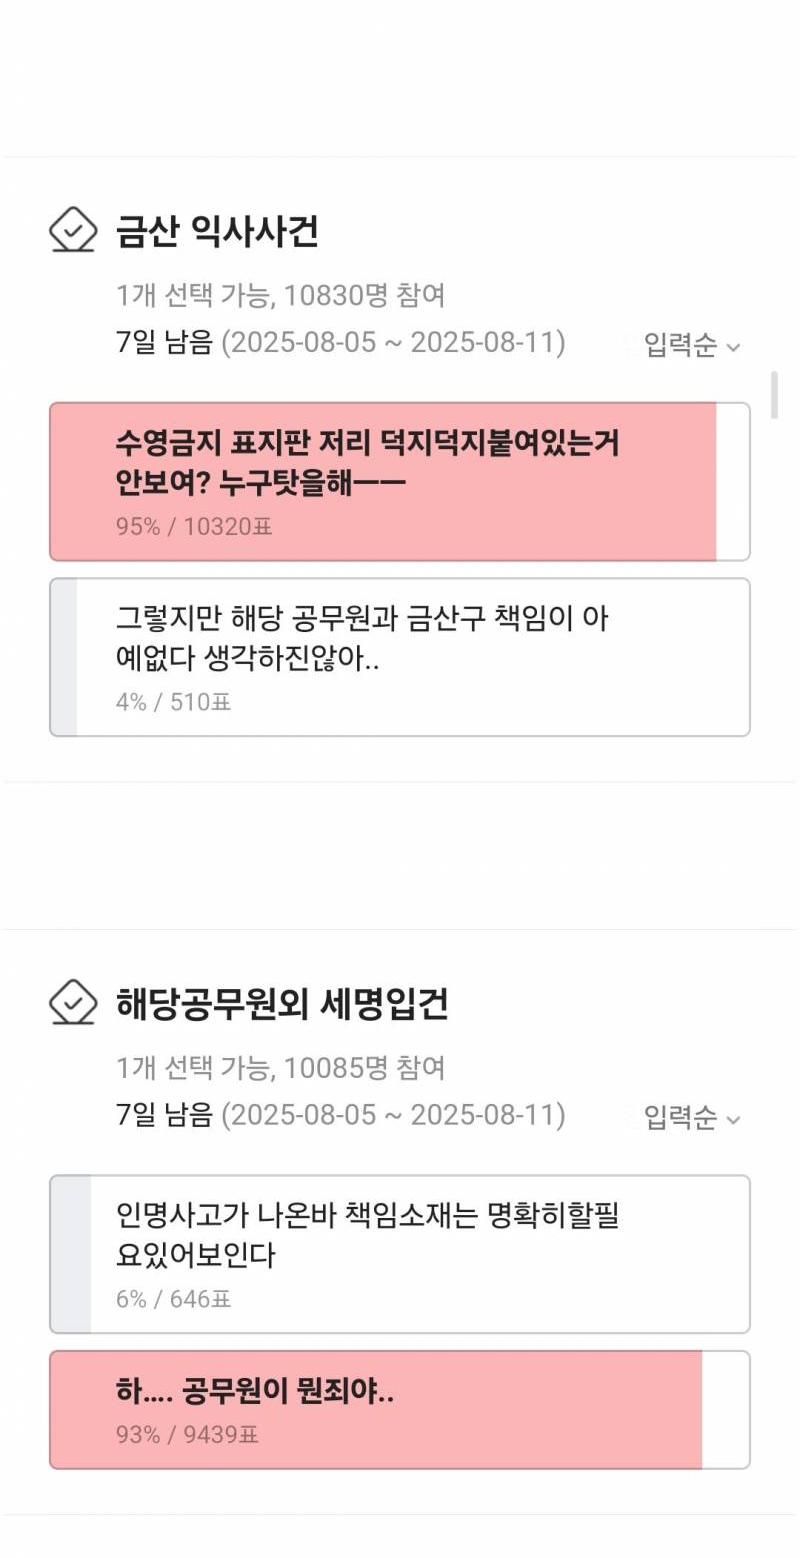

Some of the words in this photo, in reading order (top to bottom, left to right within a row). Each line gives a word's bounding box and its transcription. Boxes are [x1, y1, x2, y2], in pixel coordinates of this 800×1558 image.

[116, 214, 181, 249] 금산
[191, 214, 318, 250] 익사사건
[644, 332, 718, 359] 입력순
[116, 986, 309, 1022] 해당공무원외
[319, 986, 449, 1022] 세명입건
[115, 1376, 173, 1406] 하....
[181, 1376, 288, 1407] 공무원이
[296, 1376, 394, 1406] 뭔죄야..
